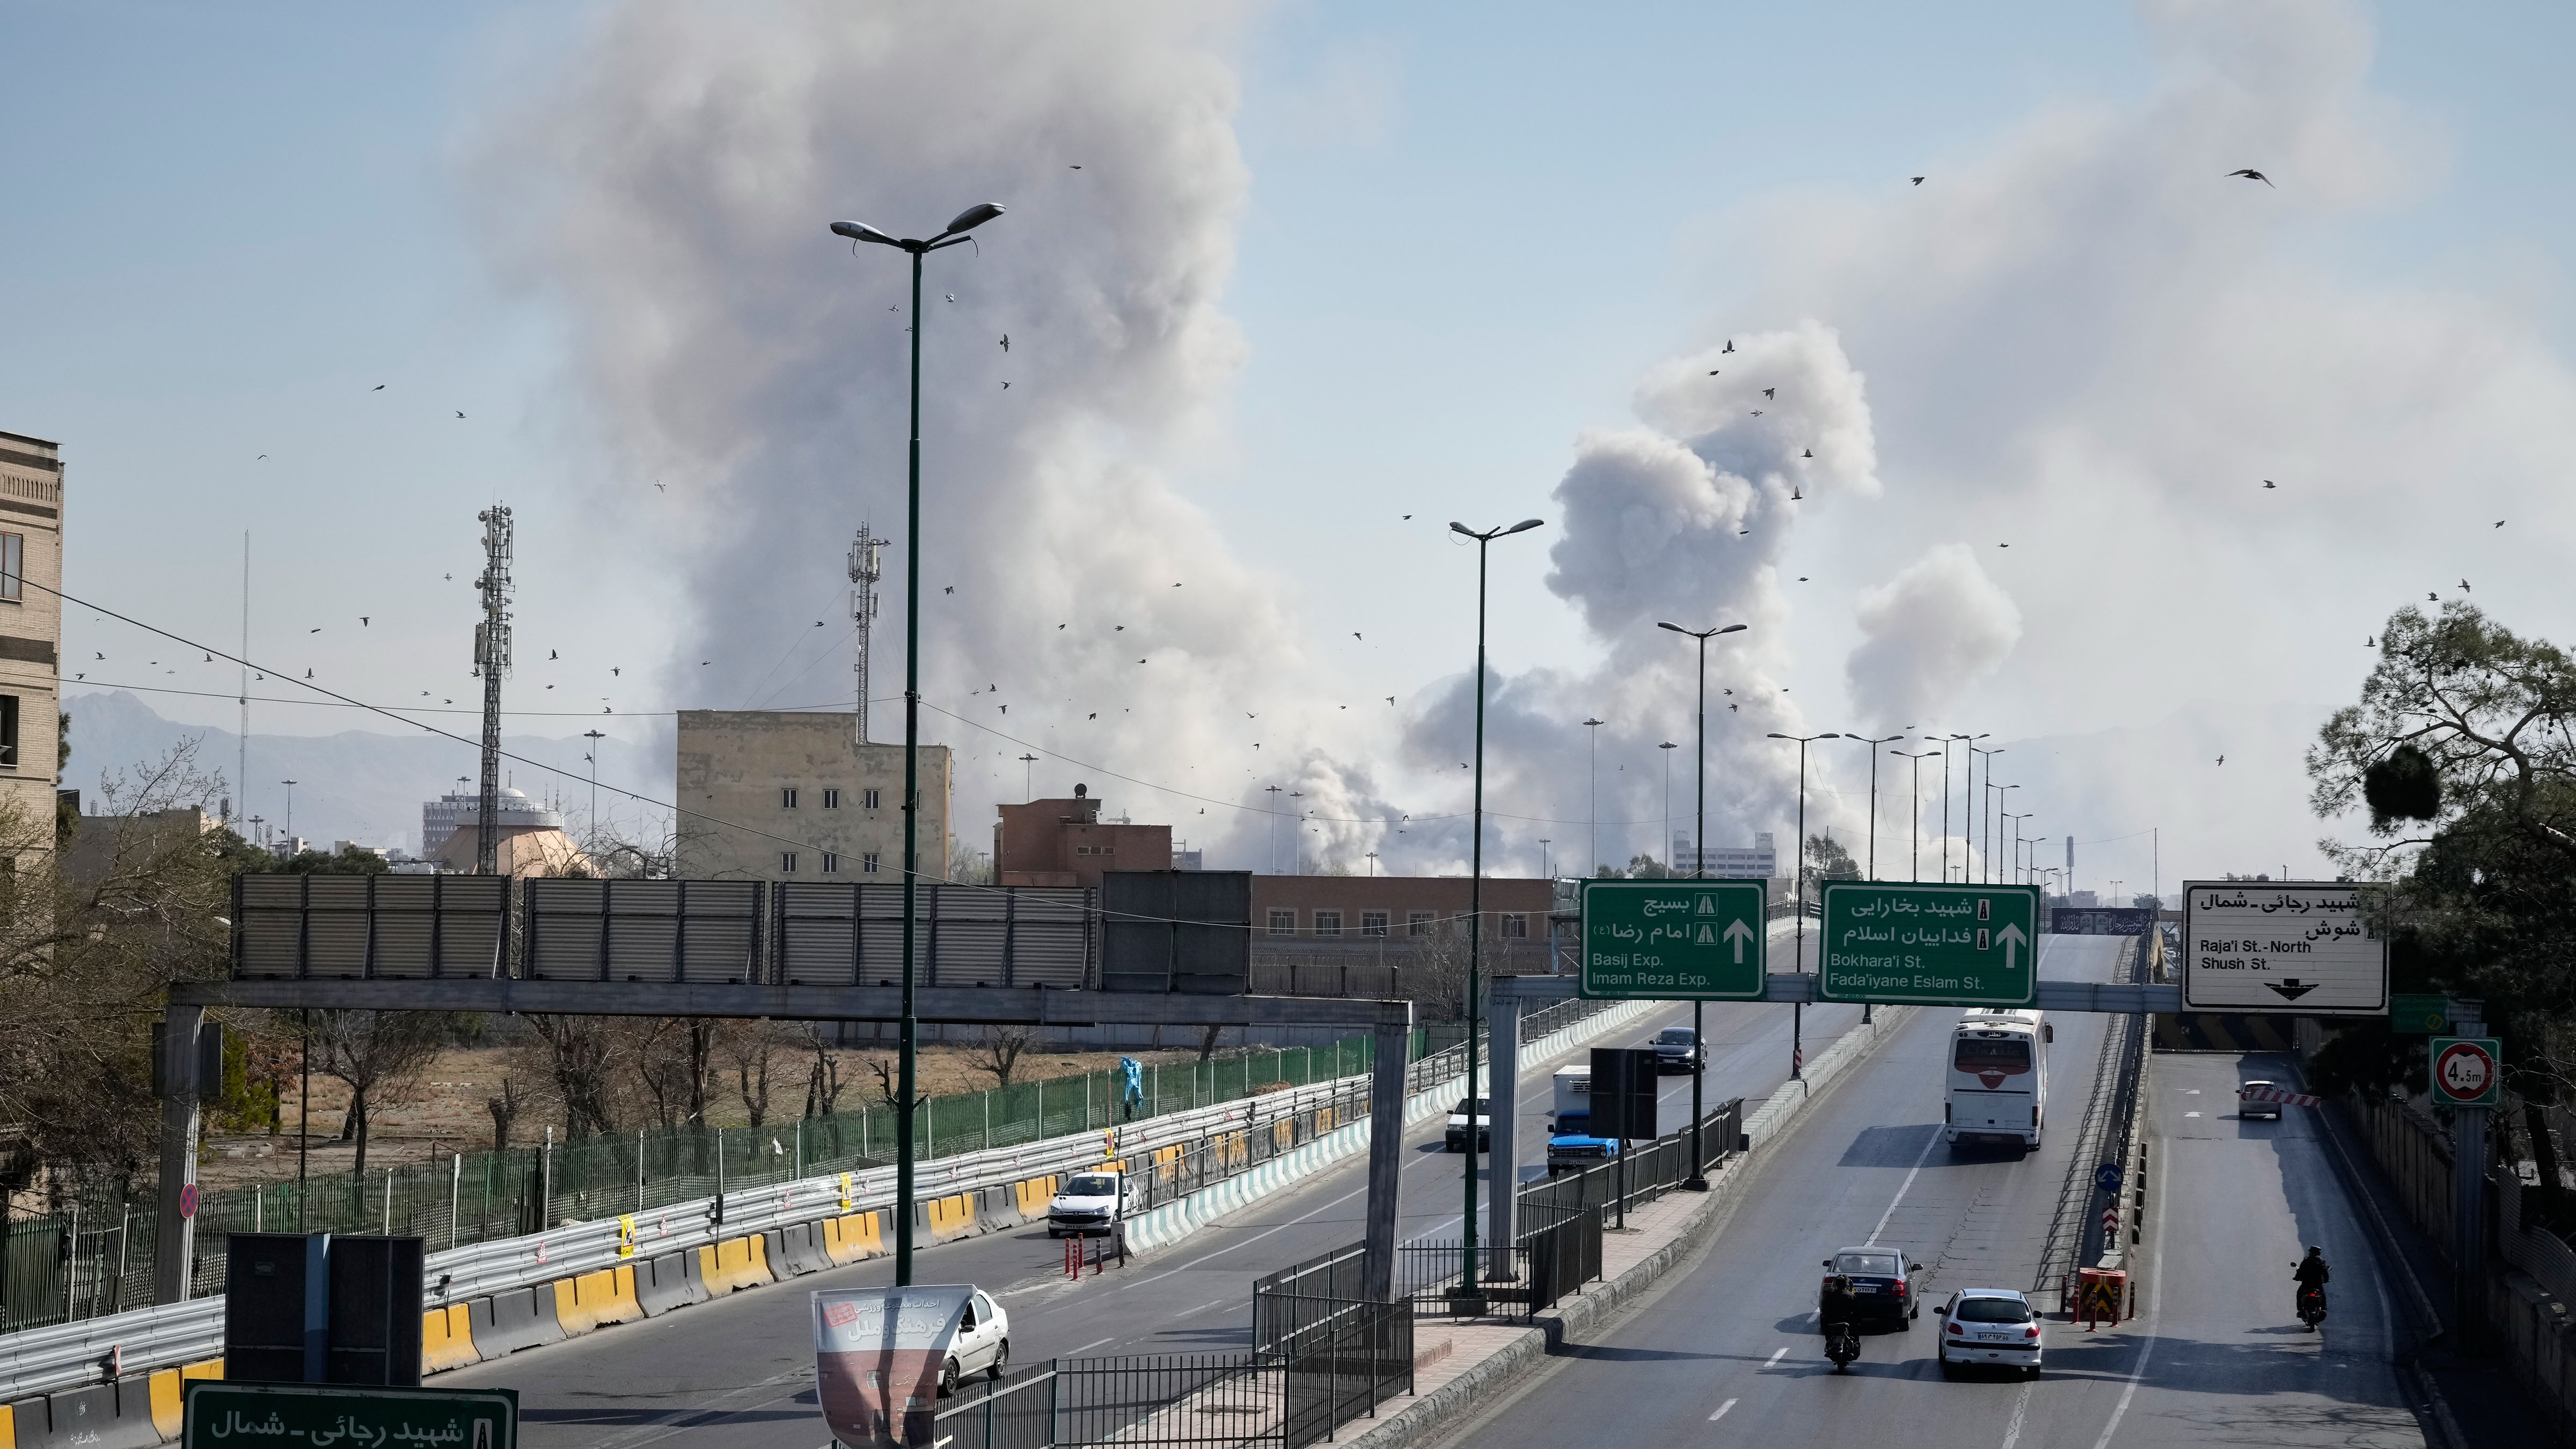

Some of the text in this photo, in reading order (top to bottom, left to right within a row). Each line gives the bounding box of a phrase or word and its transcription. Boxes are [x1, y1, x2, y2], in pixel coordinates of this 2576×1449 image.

[1643, 899, 1689, 917] بسیج
[1851, 897, 1972, 918] شهید بخارایی
[2200, 891, 2248, 910] شمال
[2316, 893, 2361, 913] شهید
[1613, 923, 1643, 943] رضا
[1650, 924, 1689, 945] امام
[1843, 926, 1971, 947] فداییان اسلام
[2305, 920, 2360, 941] شوش
[2200, 940, 2237, 954] Raja'i
[1593, 953, 1664, 969] Basij Exp.
[1831, 953, 1925, 969] Bokhara'i St.
[2201, 957, 2270, 970] Shush St.
[1593, 972, 1710, 987] Imam Reza Exp.
[1830, 972, 1984, 990] Fada'iyane Eslam St.
[848, 1319, 882, 1342] ملل
[892, 1313, 947, 1338] فرهنگ
[211, 1410, 285, 1438] شمال
[393, 1418, 464, 1448] شهید
